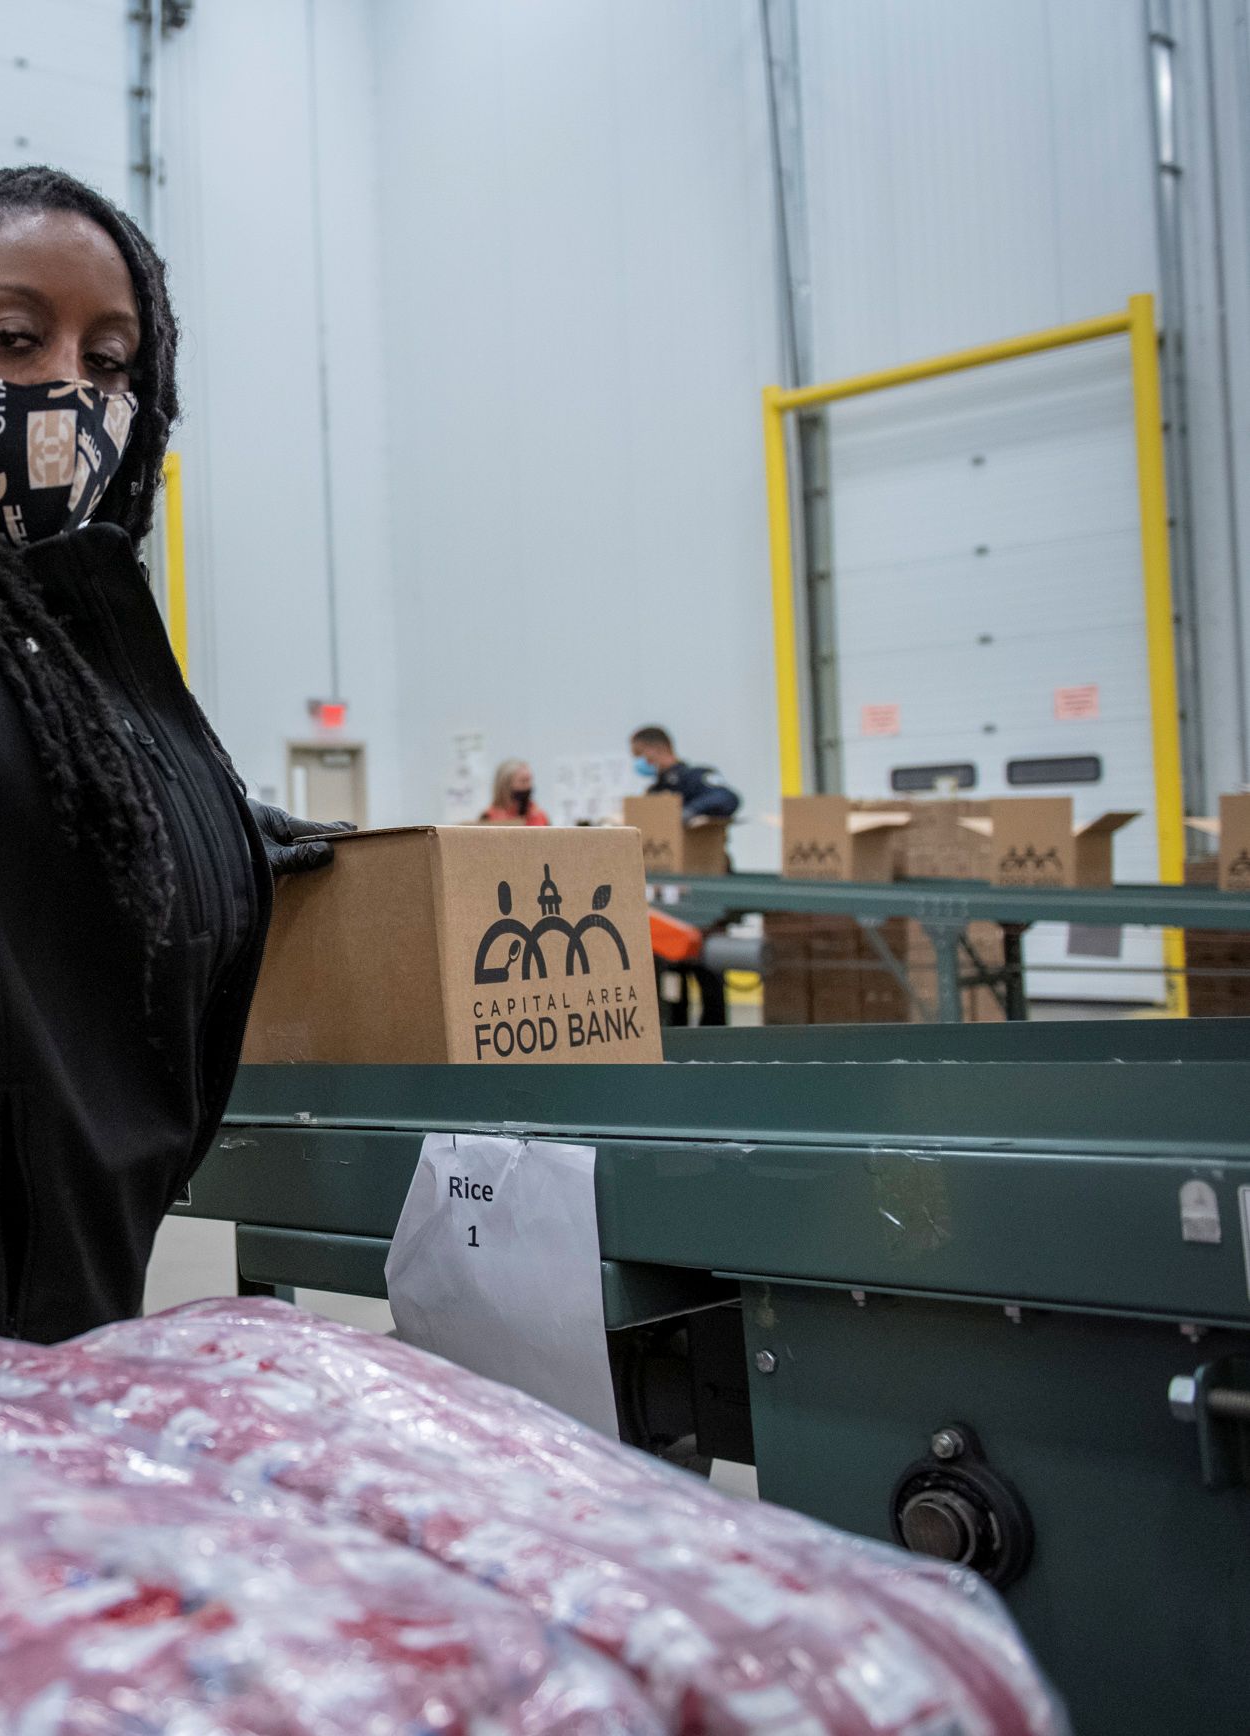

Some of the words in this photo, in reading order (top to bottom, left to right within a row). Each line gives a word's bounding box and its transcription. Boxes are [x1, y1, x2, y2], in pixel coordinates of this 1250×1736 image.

[473, 993, 570, 1018] CAPITAL
[586, 985, 638, 1006] AREA
[474, 1016, 558, 1061] FOOD
[567, 1006, 641, 1048] BANK
[449, 1176, 494, 1202] Rice
[467, 1225, 480, 1248] 1
